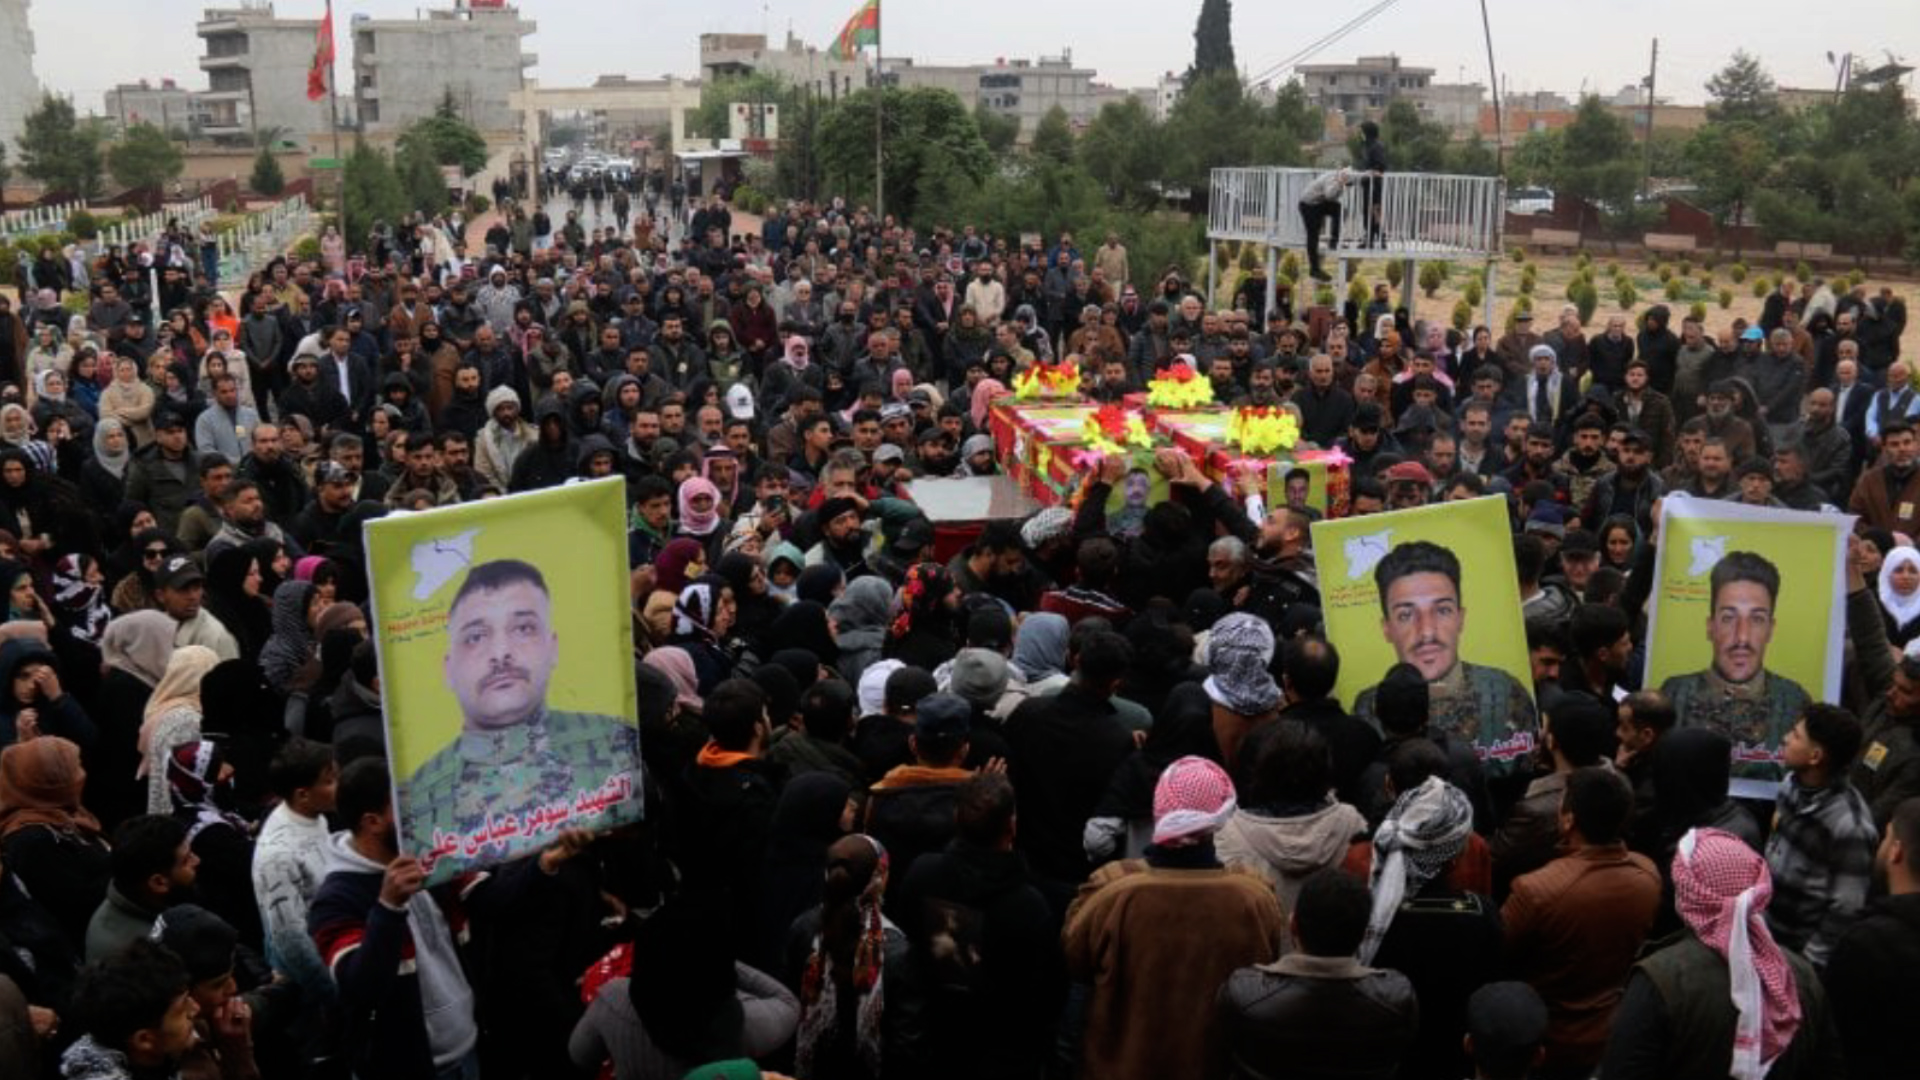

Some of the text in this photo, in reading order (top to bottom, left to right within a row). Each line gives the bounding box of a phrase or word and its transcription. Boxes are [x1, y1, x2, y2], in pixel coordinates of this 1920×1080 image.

[1490, 731, 1534, 762] الشهيد
[419, 772, 632, 874] الشهيد سومر عباس علي
